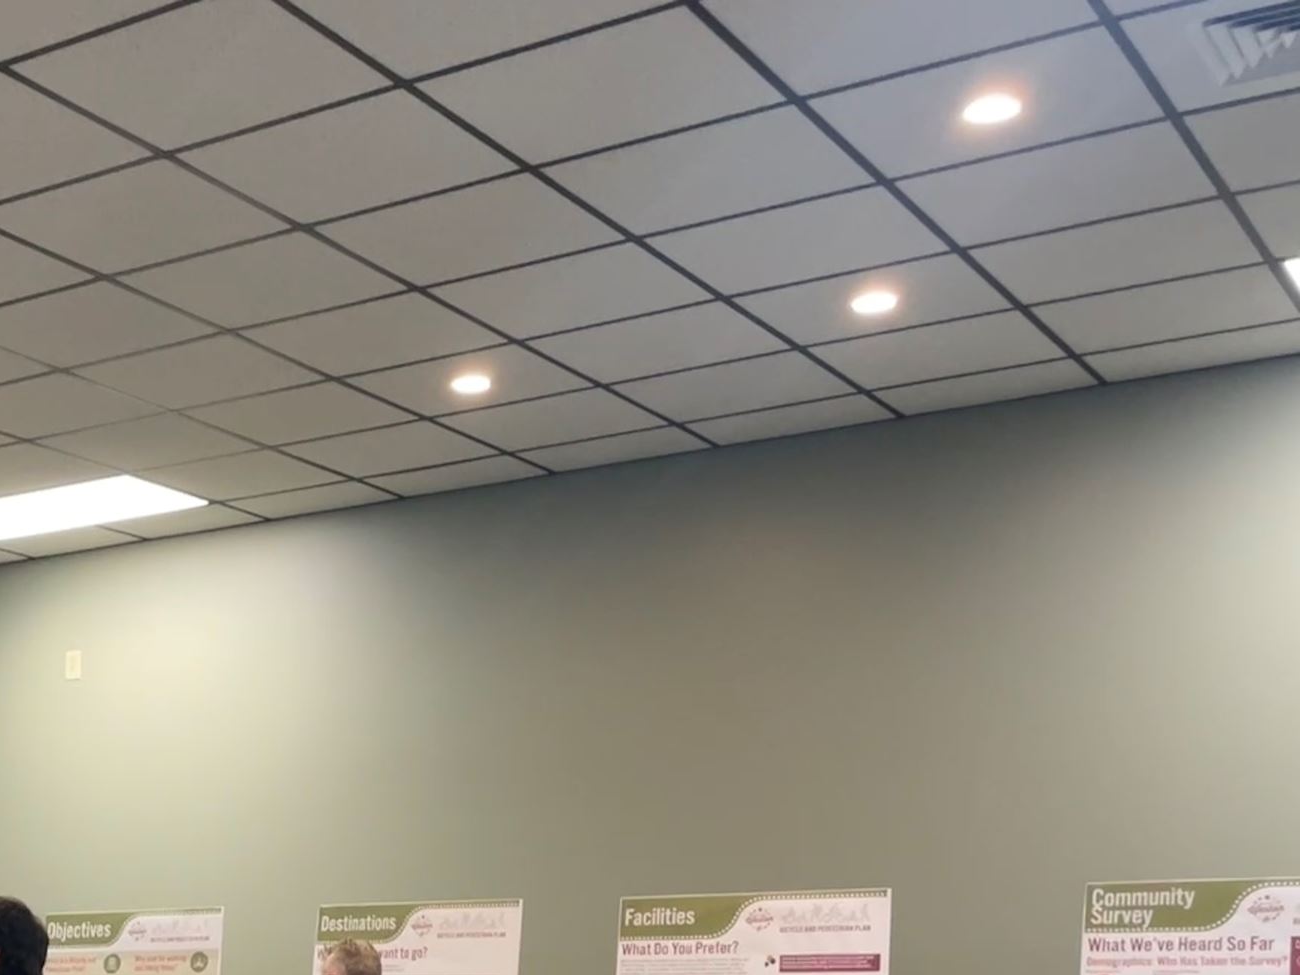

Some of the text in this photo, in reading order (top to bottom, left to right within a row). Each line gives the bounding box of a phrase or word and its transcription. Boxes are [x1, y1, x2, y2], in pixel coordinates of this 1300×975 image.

[1092, 888, 1195, 909] Community
[320, 914, 397, 932] Destinations
[625, 907, 696, 926] Facilities
[1090, 907, 1153, 929] Survey
[47, 919, 112, 942] Objectives
[622, 940, 739, 956] What Do You Prefer?
[1088, 936, 1275, 952] What We've Heard So Far
[400, 947, 410, 959] to
[411, 946, 428, 961] go?
